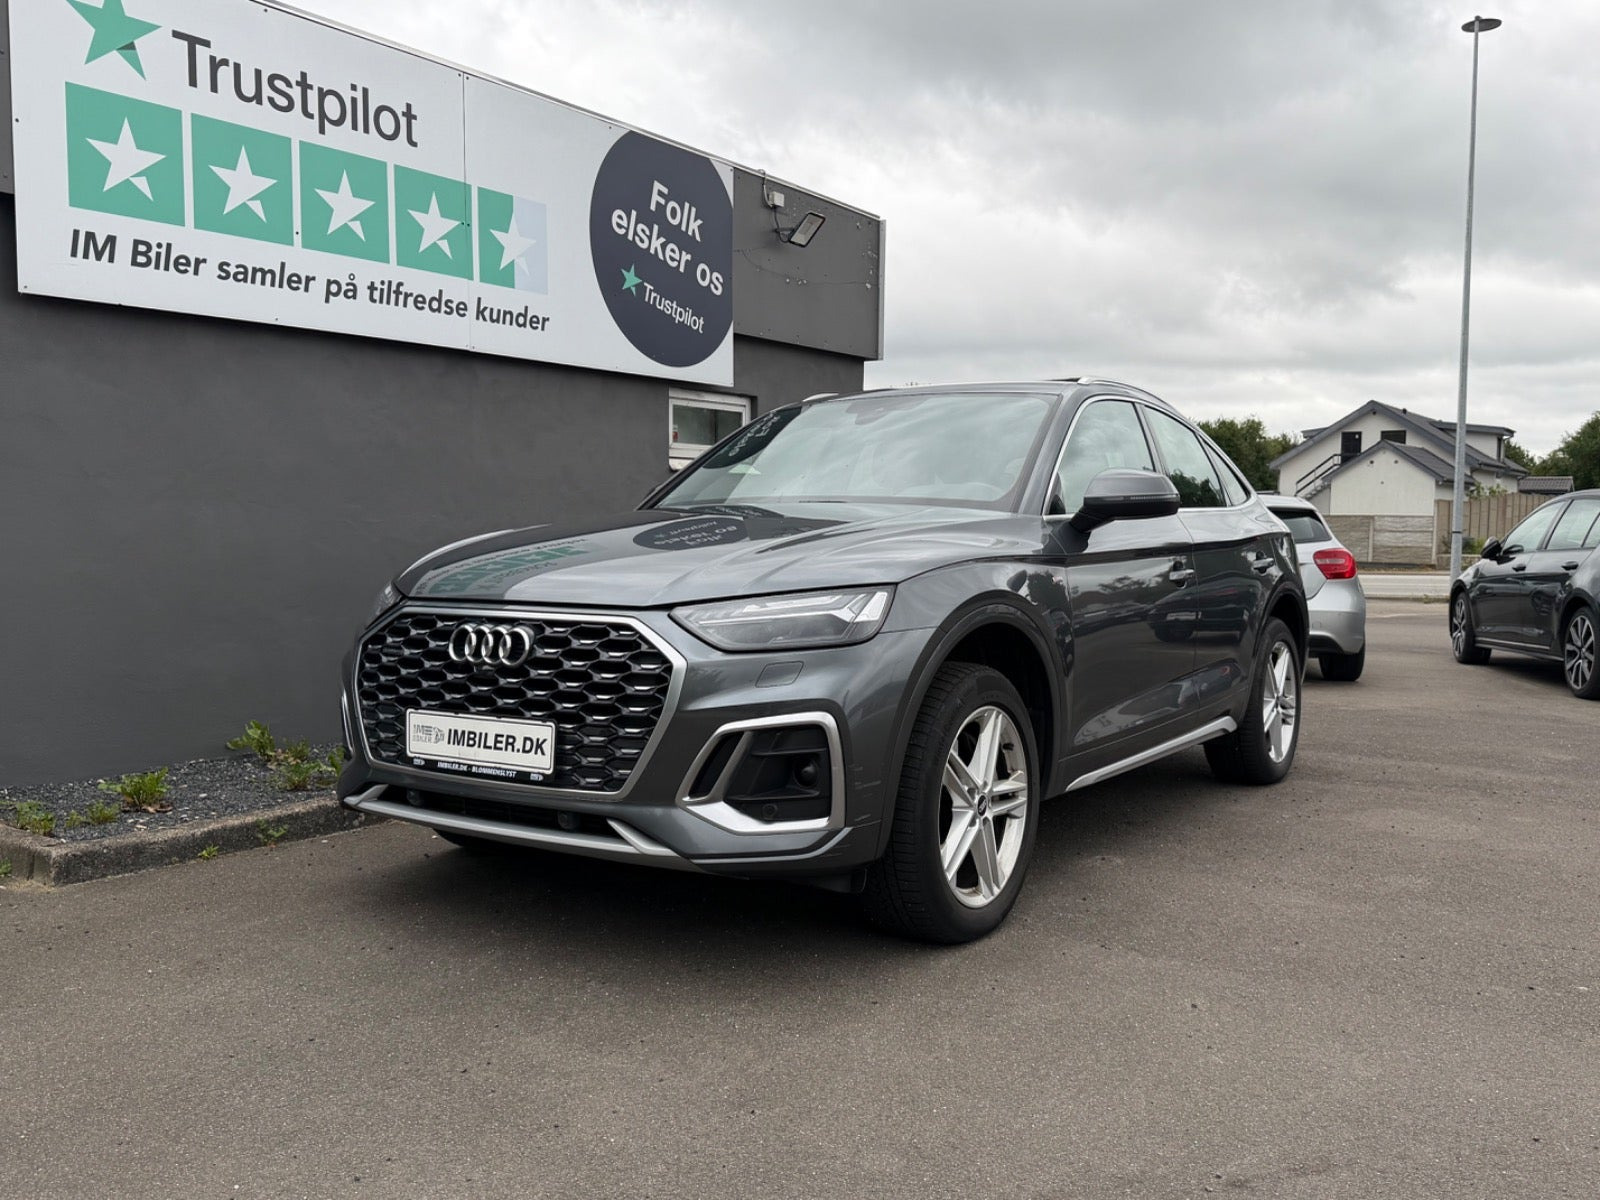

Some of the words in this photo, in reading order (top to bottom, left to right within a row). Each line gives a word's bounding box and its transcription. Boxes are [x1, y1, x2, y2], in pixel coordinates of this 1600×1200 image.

[171, 29, 418, 148] Trustpilot
[649, 180, 703, 242] Folk
[70, 228, 117, 263] IM
[130, 238, 207, 276] Biler
[216, 261, 316, 293] samler
[325, 272, 358, 304] på
[367, 279, 468, 318] tilfredse
[475, 296, 550, 332] kunder
[611, 209, 692, 273] elsker
[696, 263, 724, 296] os
[643, 282, 705, 334] Trustpilot
[447, 728, 548, 756] IMBILER.DK
